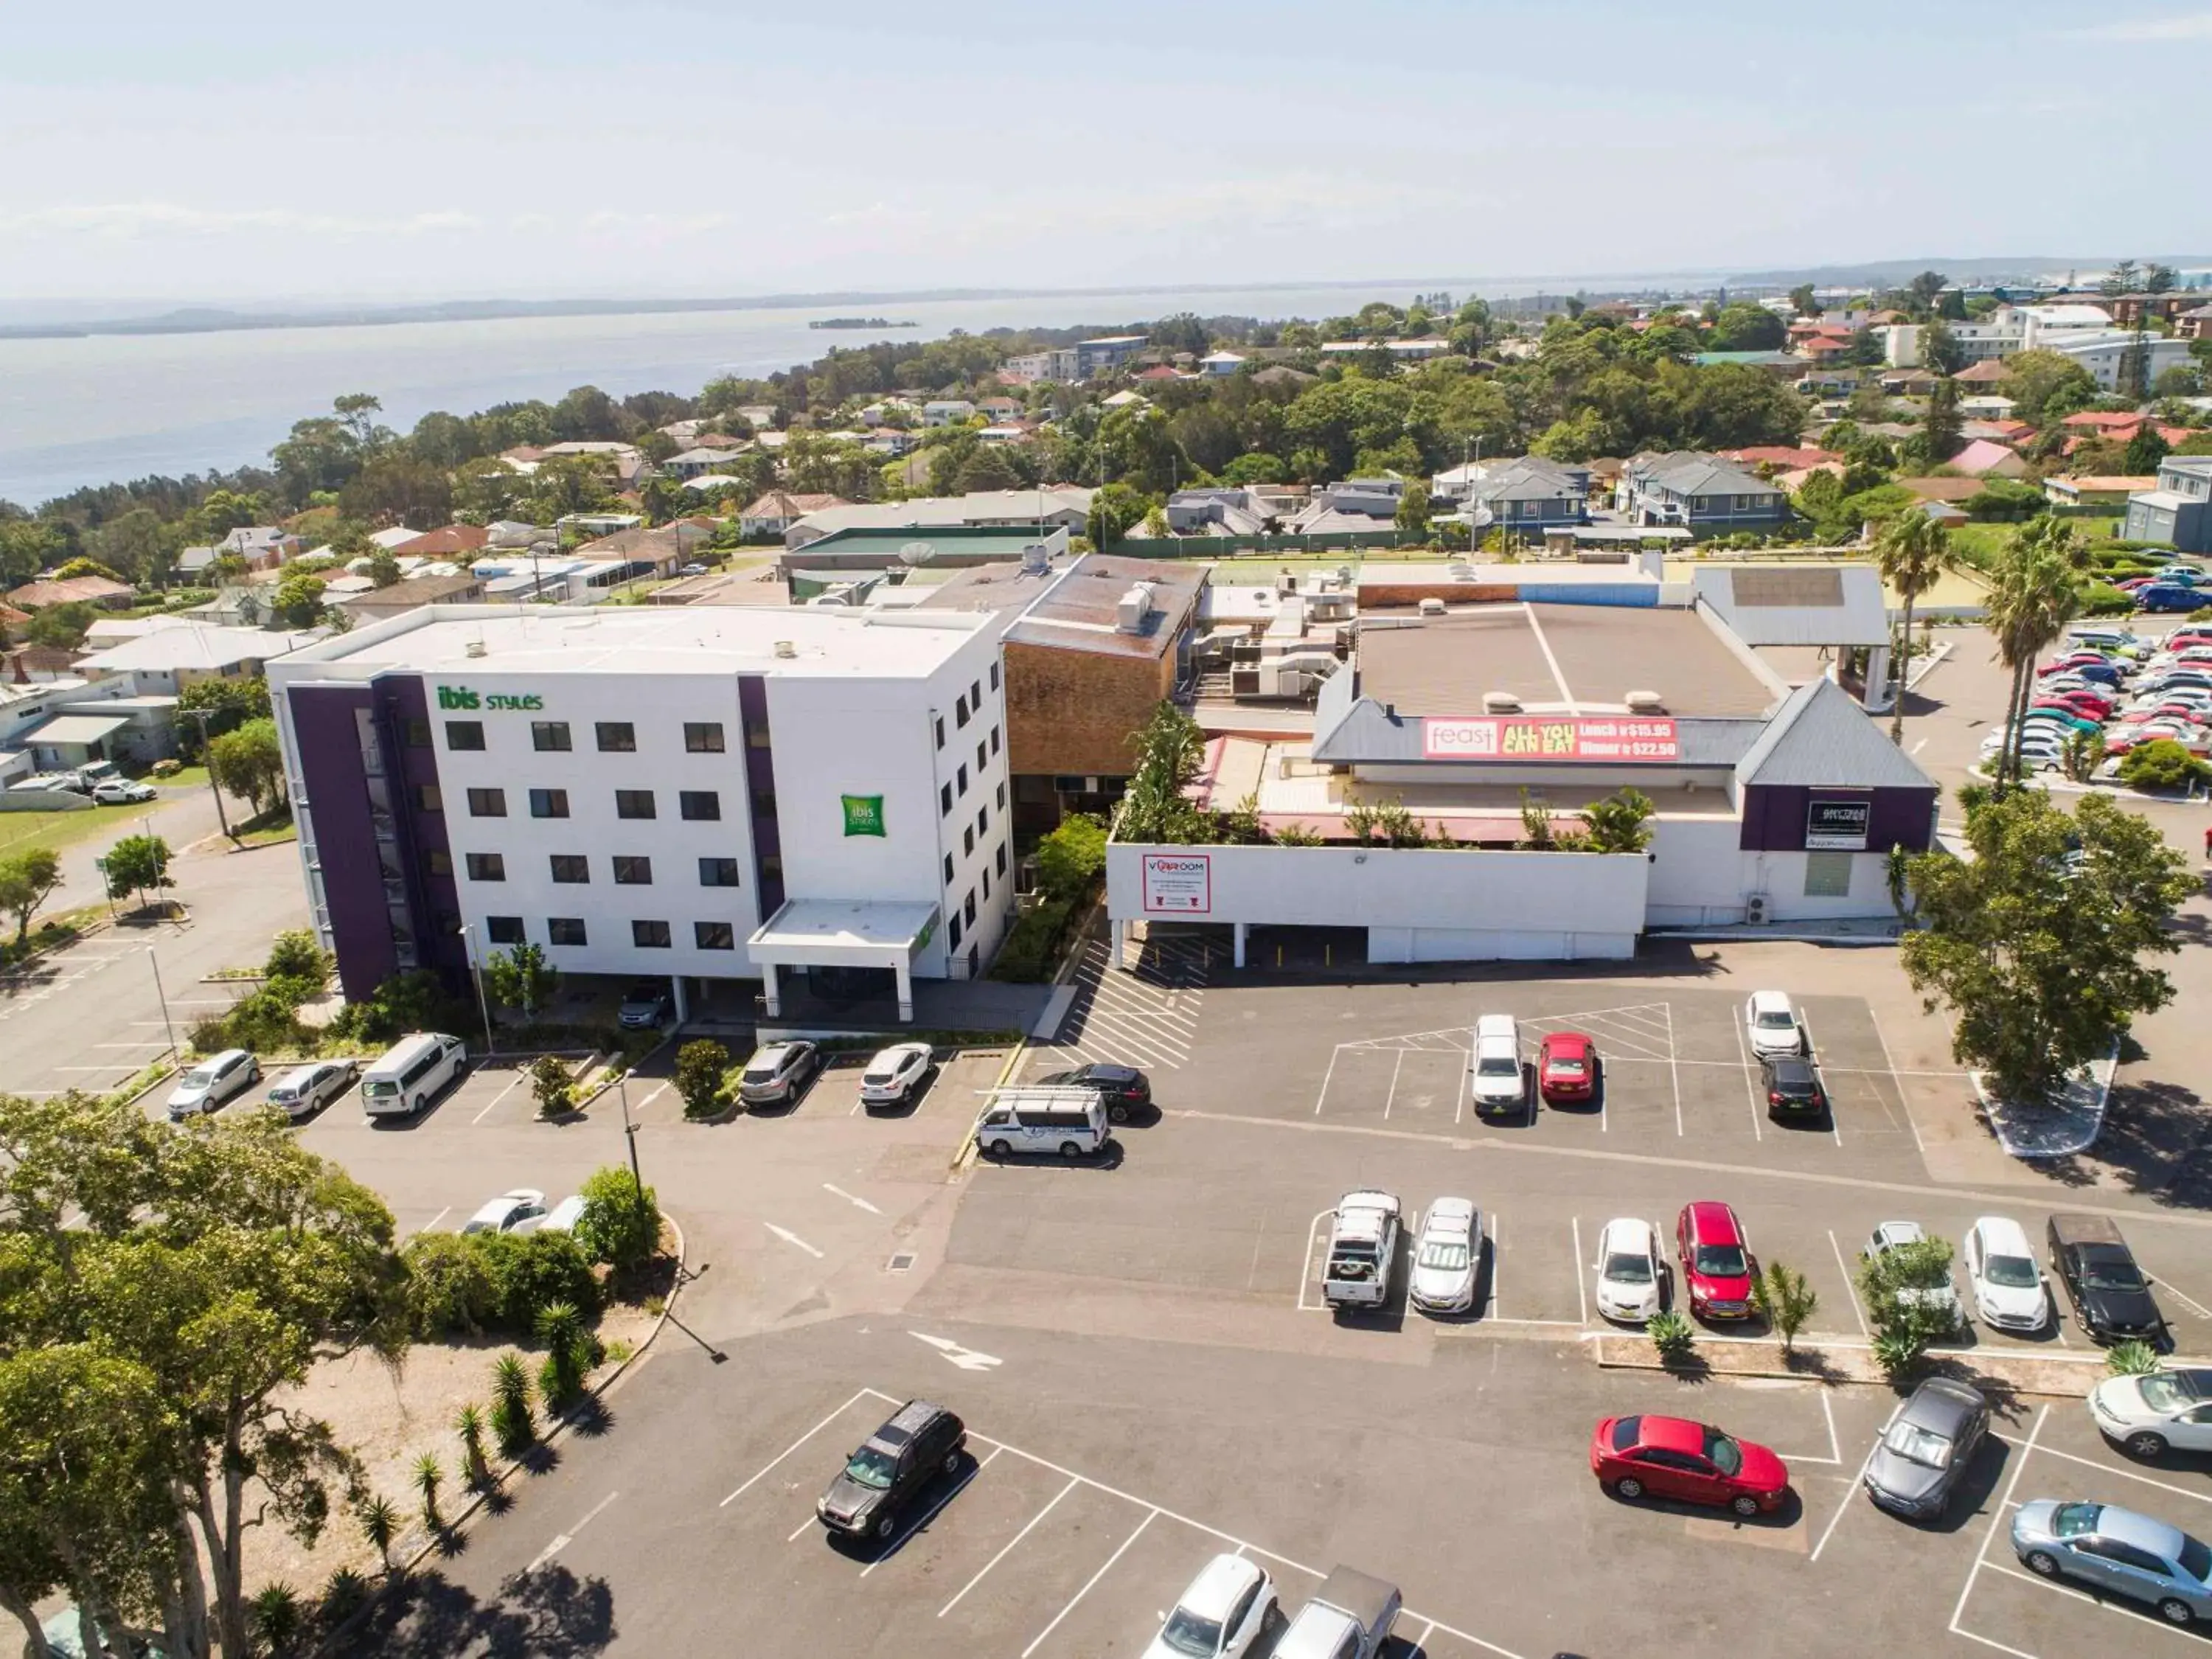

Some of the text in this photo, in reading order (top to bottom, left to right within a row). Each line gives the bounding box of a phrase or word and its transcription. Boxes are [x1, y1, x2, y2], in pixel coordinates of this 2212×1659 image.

[437, 686, 481, 709] ibis
[1431, 727, 1493, 751] feast
[1505, 724, 1575, 739] ALL YOU
[1502, 738, 1574, 754] CAN EAT
[852, 804, 874, 818] ibis
